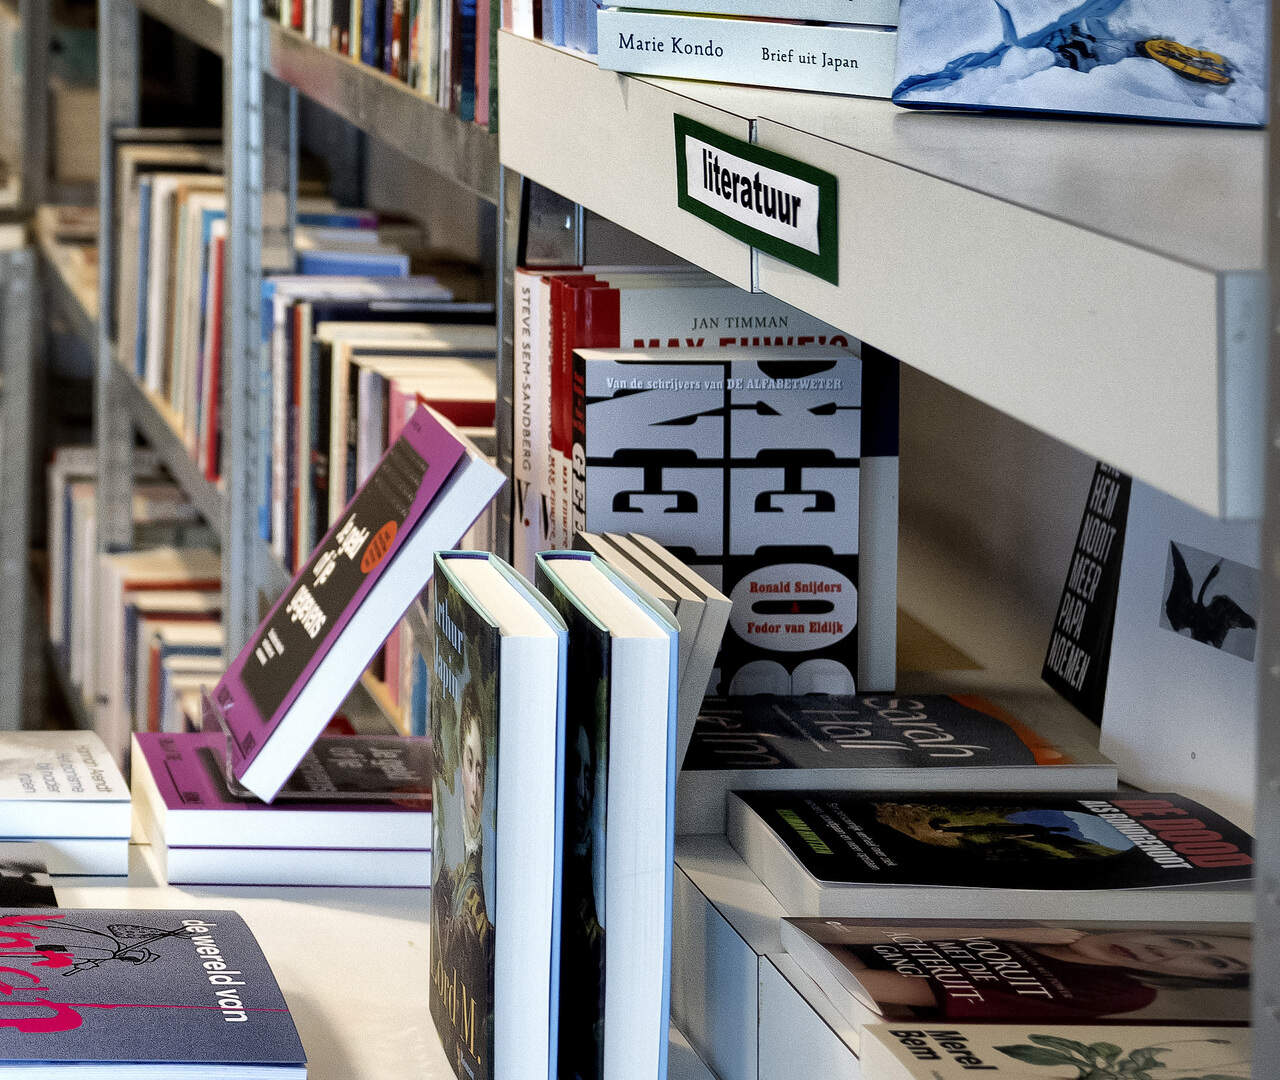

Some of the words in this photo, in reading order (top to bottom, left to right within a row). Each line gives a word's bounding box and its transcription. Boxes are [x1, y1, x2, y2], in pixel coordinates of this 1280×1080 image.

[618, 33, 664, 53] Marie
[671, 37, 724, 58] Kondo
[761, 48, 793, 64] Brief
[798, 52, 817, 65] uit
[821, 53, 859, 72] Japan
[702, 148, 801, 228] literatuur
[521, 286, 531, 337] STEVE
[692, 317, 720, 331] JAN
[724, 315, 789, 329] TIMMAN
[521, 341, 532, 471] SEM-SANDBERG
[606, 377, 628, 389] Van
[630, 377, 643, 389] de
[647, 377, 701, 392] schrijvers
[704, 379, 723, 390] van
[727, 378, 742, 390] DE
[747, 378, 843, 391] ALFABETWETER
[572, 442, 587, 534] GEE
[1078, 513, 1117, 564] NOOIT
[749, 581, 791, 594] Ronald
[794, 581, 842, 595] Snijders
[1068, 552, 1102, 602] MEER
[286, 583, 327, 639] gegevens
[747, 622, 781, 634] Fedor
[785, 623, 806, 634] van
[809, 621, 844, 635] Eldijk
[1057, 592, 1087, 640] PAPA
[1047, 635, 1091, 692] NOEMEN
[800, 709, 914, 752] Hall
[863, 697, 990, 758] Sarah
[88, 768, 113, 792] Arendt
[1077, 800, 1120, 814] ALS
[1109, 800, 1189, 817] DE
[1098, 813, 1193, 869] BONDGENOOT
[1140, 818, 1255, 868] DOOD
[182, 919, 201, 934] de
[190, 934, 246, 987] wereld
[872, 945, 931, 978] GANG!
[881, 930, 985, 1005] ACHTERUIT-
[933, 941, 976, 962] MET
[961, 962, 999, 982] DIE
[960, 936, 1053, 999] VOORUIT
[215, 989, 248, 1023] van
[460, 980, 481, 1065] M.
[888, 1029, 942, 1061] Bem
[922, 1030, 999, 1070] Merel
